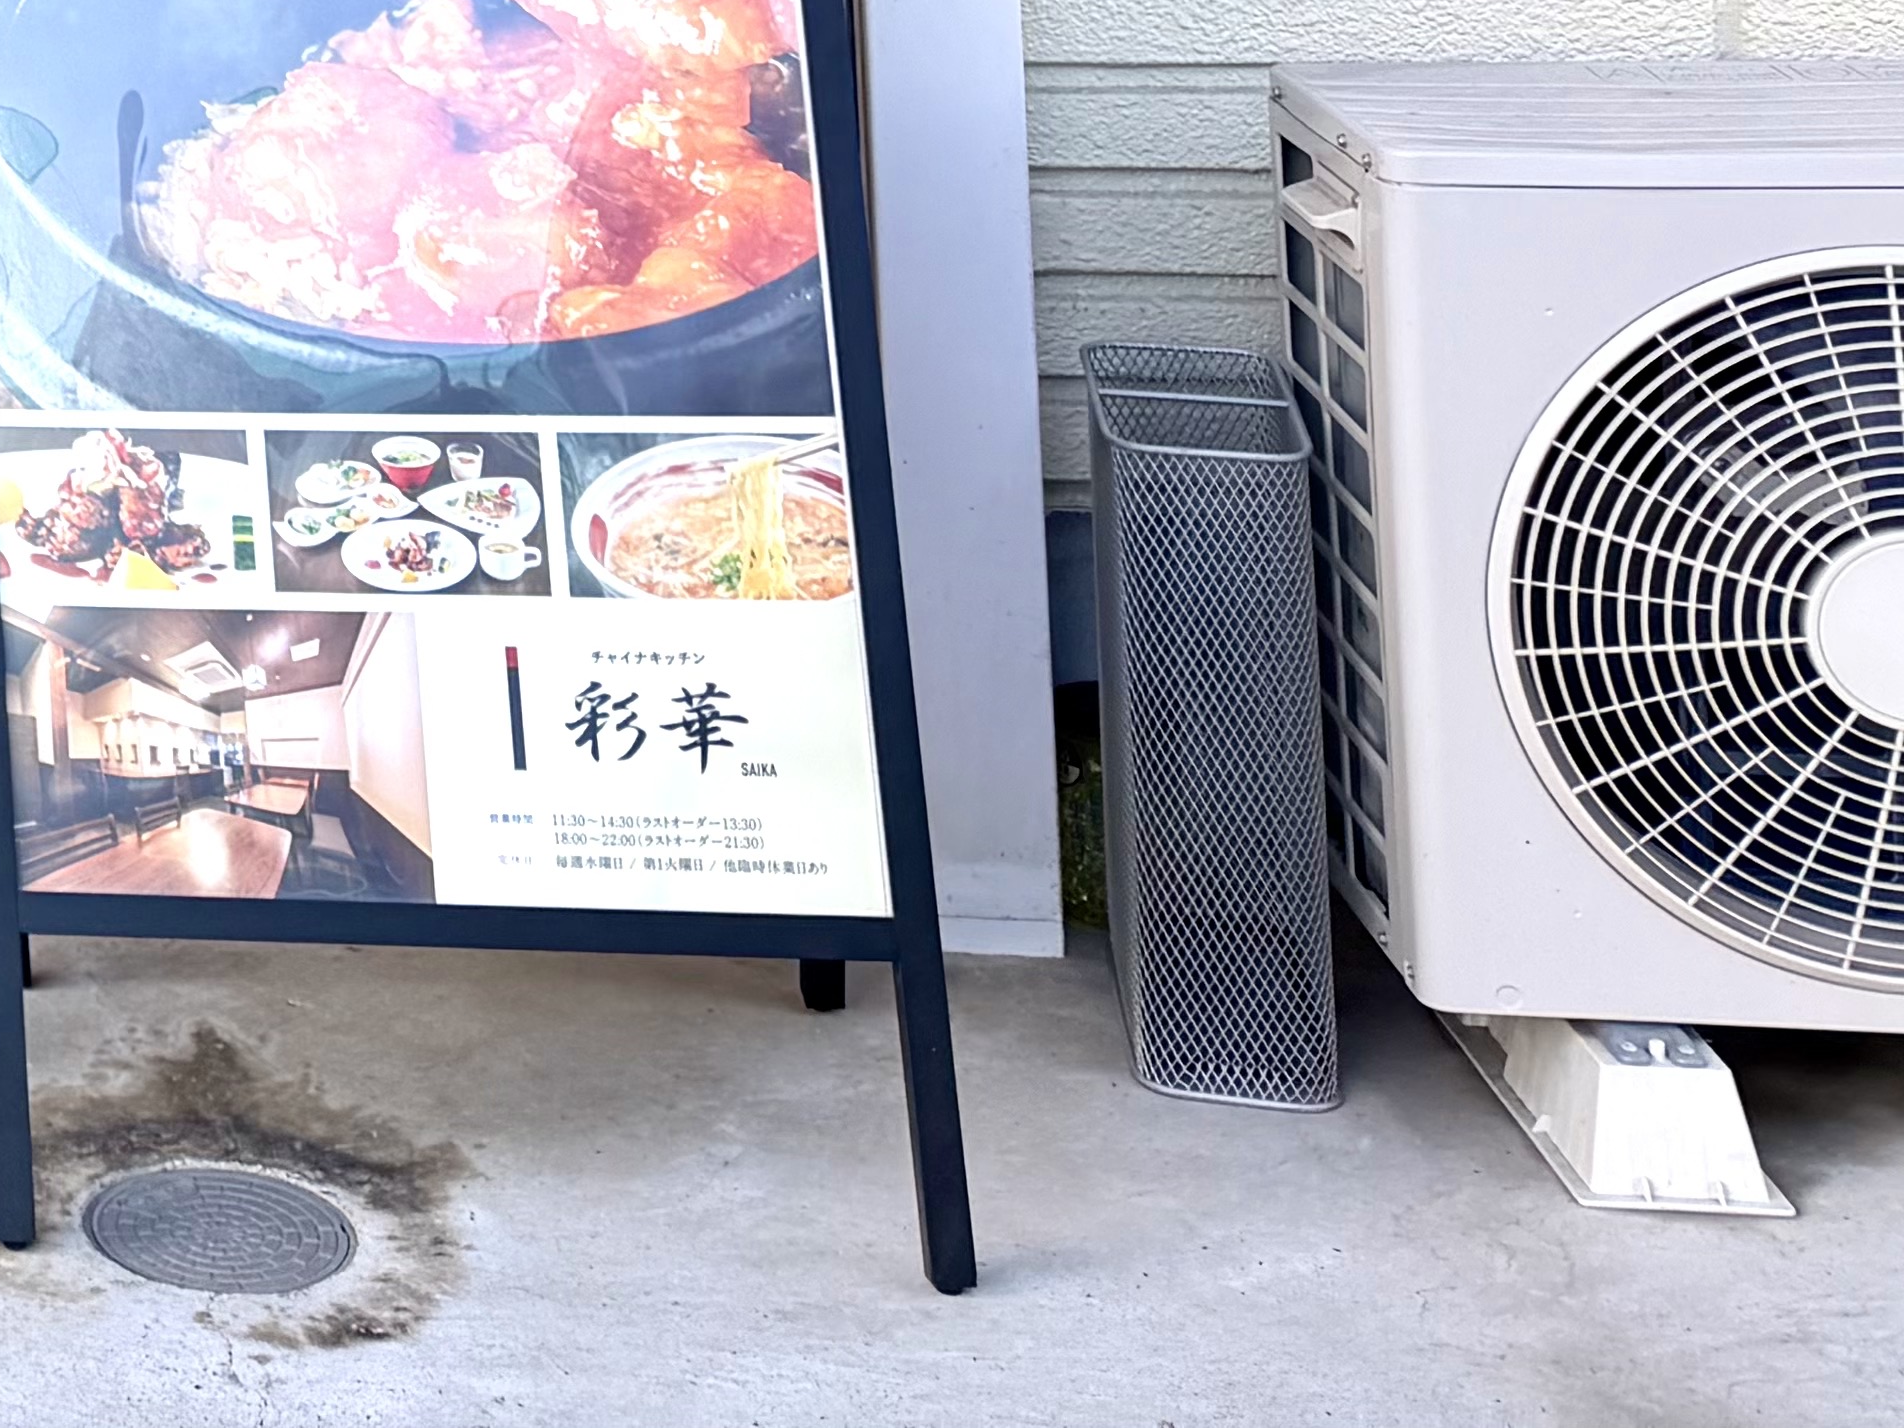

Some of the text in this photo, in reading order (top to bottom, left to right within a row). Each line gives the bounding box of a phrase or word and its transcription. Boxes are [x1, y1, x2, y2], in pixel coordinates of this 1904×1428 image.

[591, 650, 706, 666] チャイナキッチン
[565, 681, 750, 775] 彩華
[741, 762, 778, 779] SAIKA
